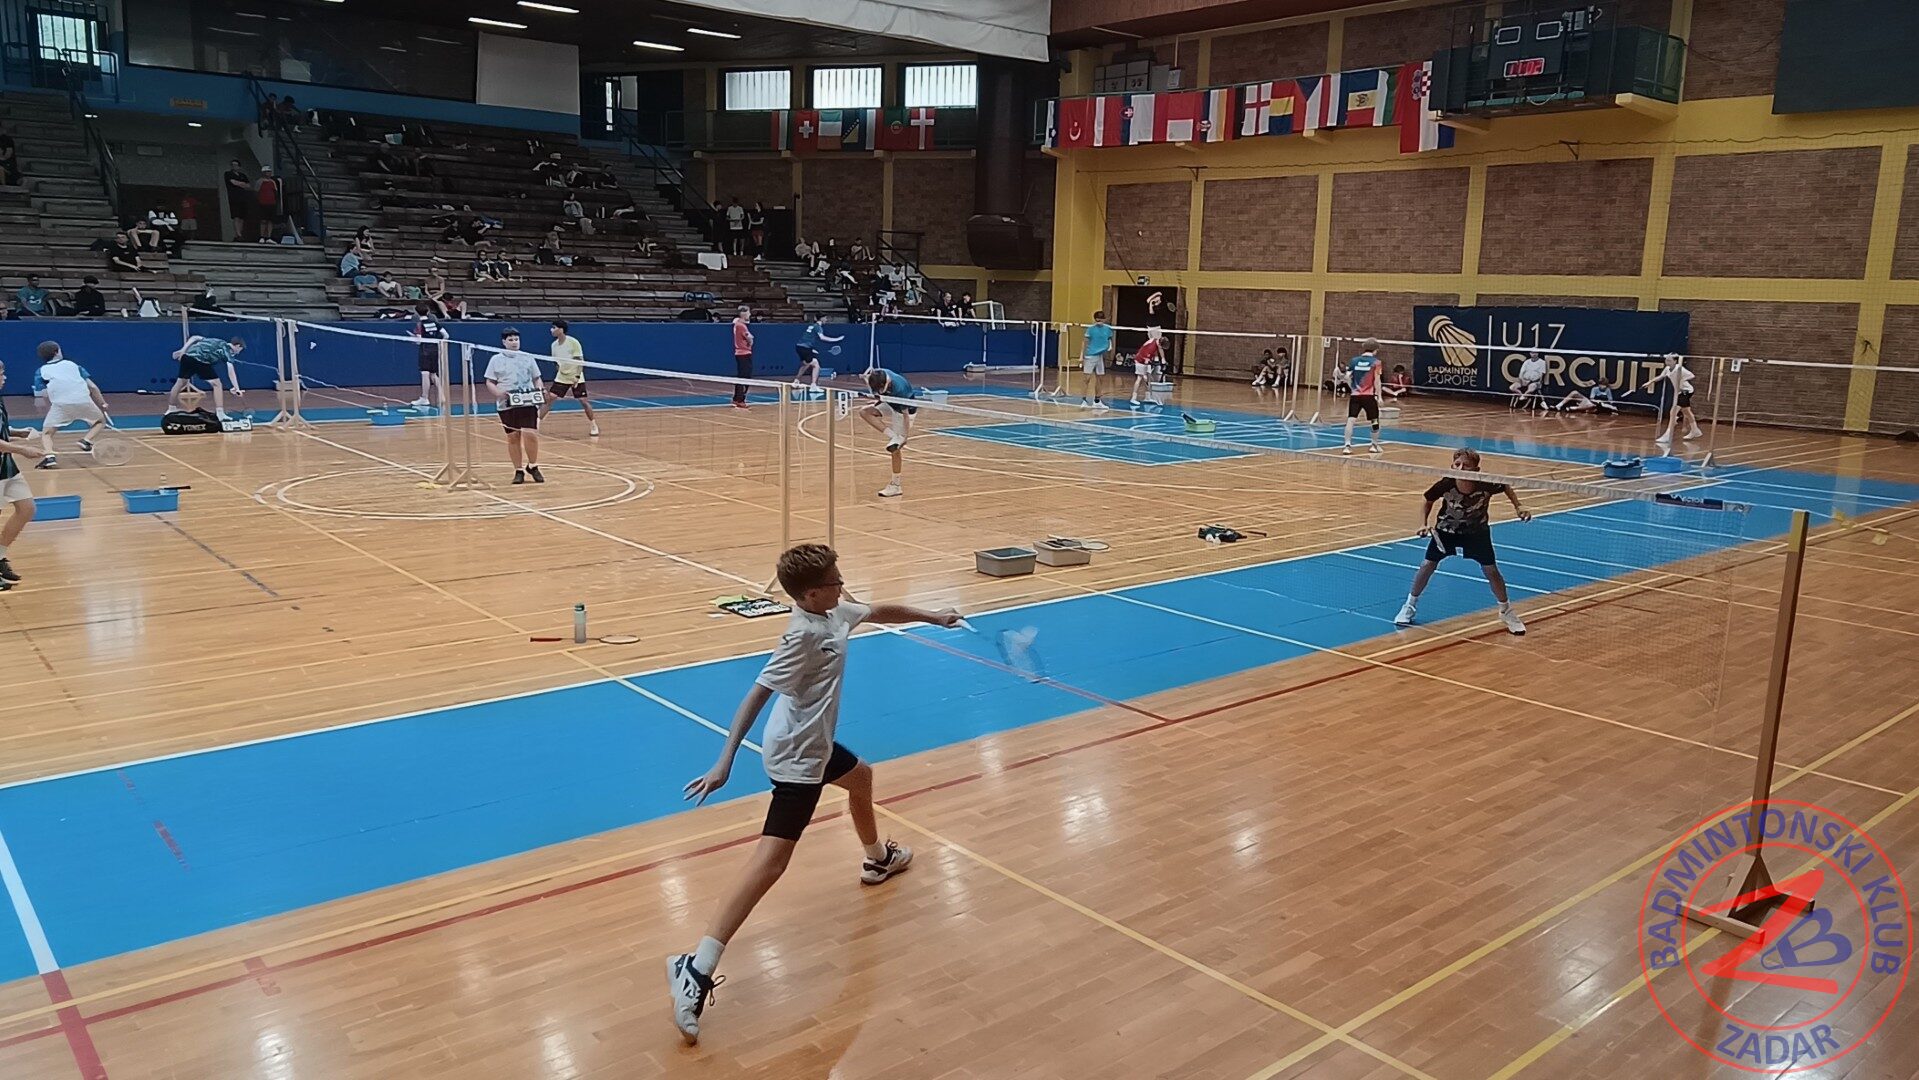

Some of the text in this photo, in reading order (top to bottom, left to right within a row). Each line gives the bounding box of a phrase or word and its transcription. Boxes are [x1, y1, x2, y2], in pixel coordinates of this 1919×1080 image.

[1502, 321, 1565, 349] U17
[1427, 366, 1478, 375] BADMINTON
[1501, 353, 1665, 394] CRCUIT
[1428, 373, 1477, 387] EUROPE
[512, 392, 543, 404] 6 6
[182, 423, 207, 432] YONEX
